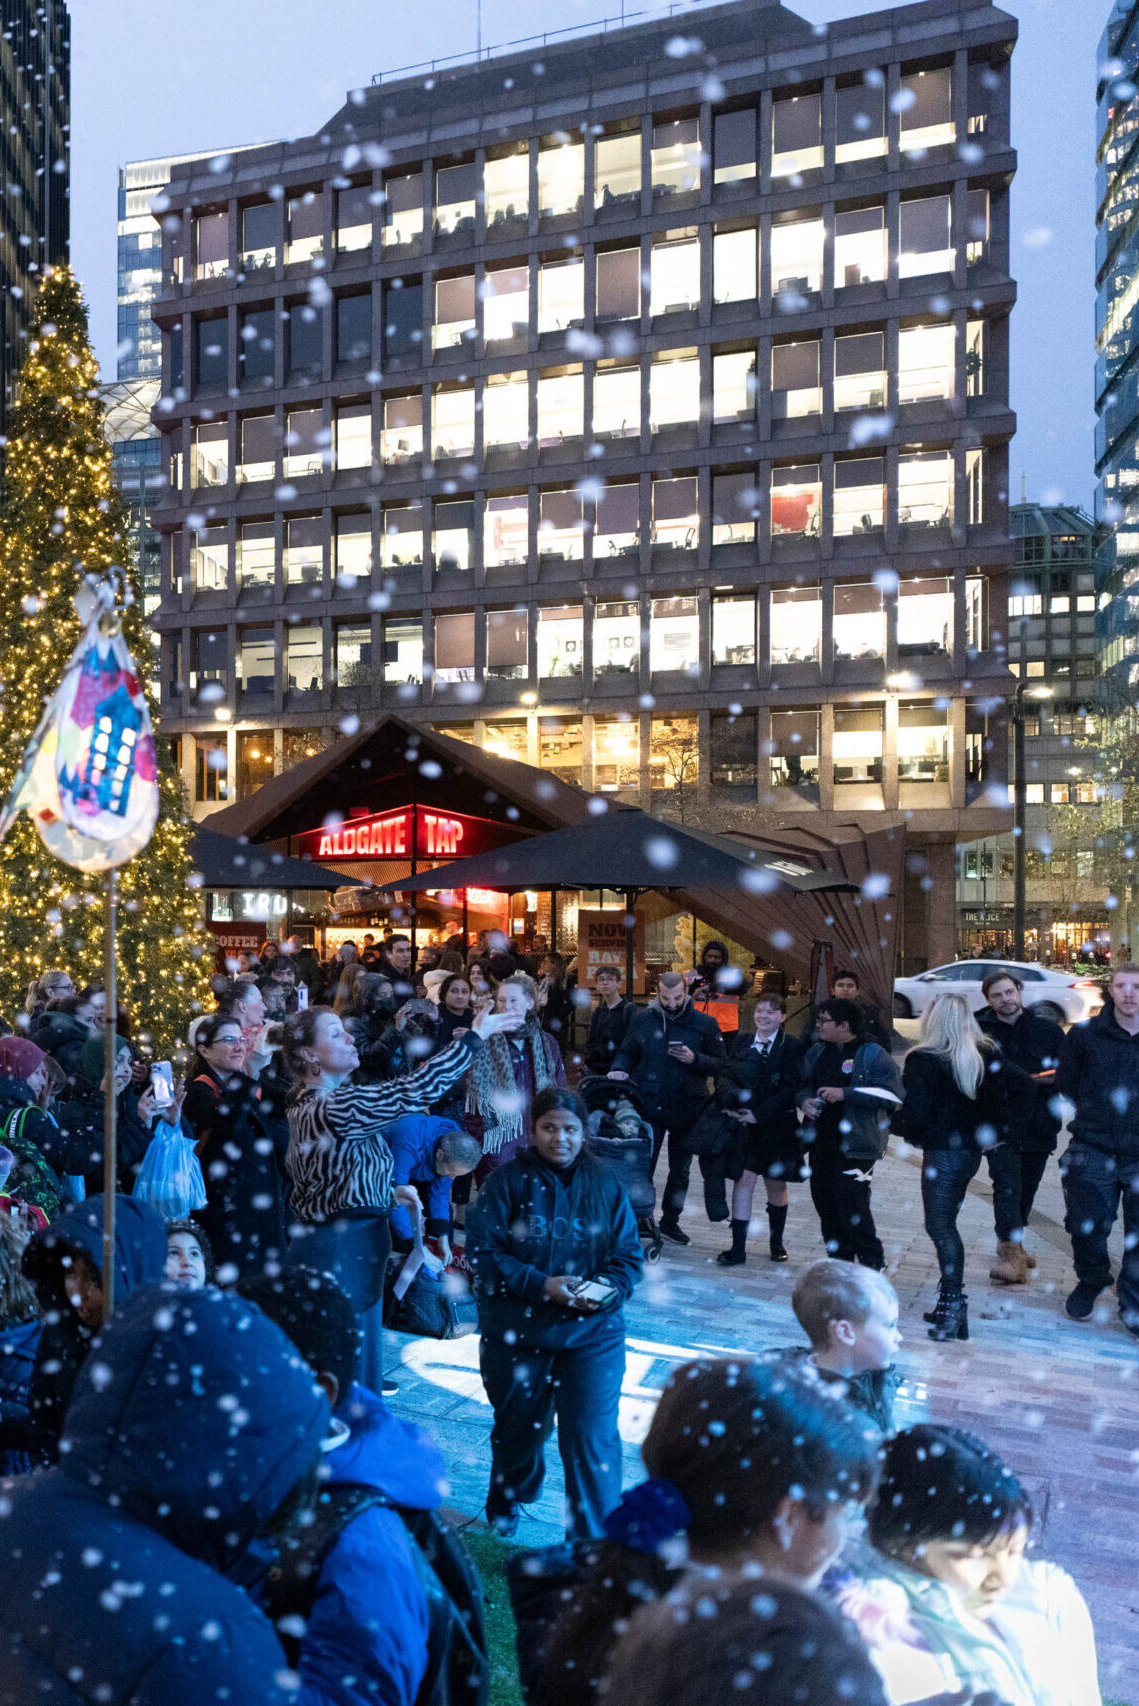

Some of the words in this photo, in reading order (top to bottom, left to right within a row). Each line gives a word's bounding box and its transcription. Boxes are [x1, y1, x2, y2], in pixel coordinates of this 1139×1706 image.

[319, 814, 406, 856] ALDGATE
[423, 814, 464, 854] TAP
[965, 912, 978, 921] THE
[979, 911, 1001, 922] AICE
